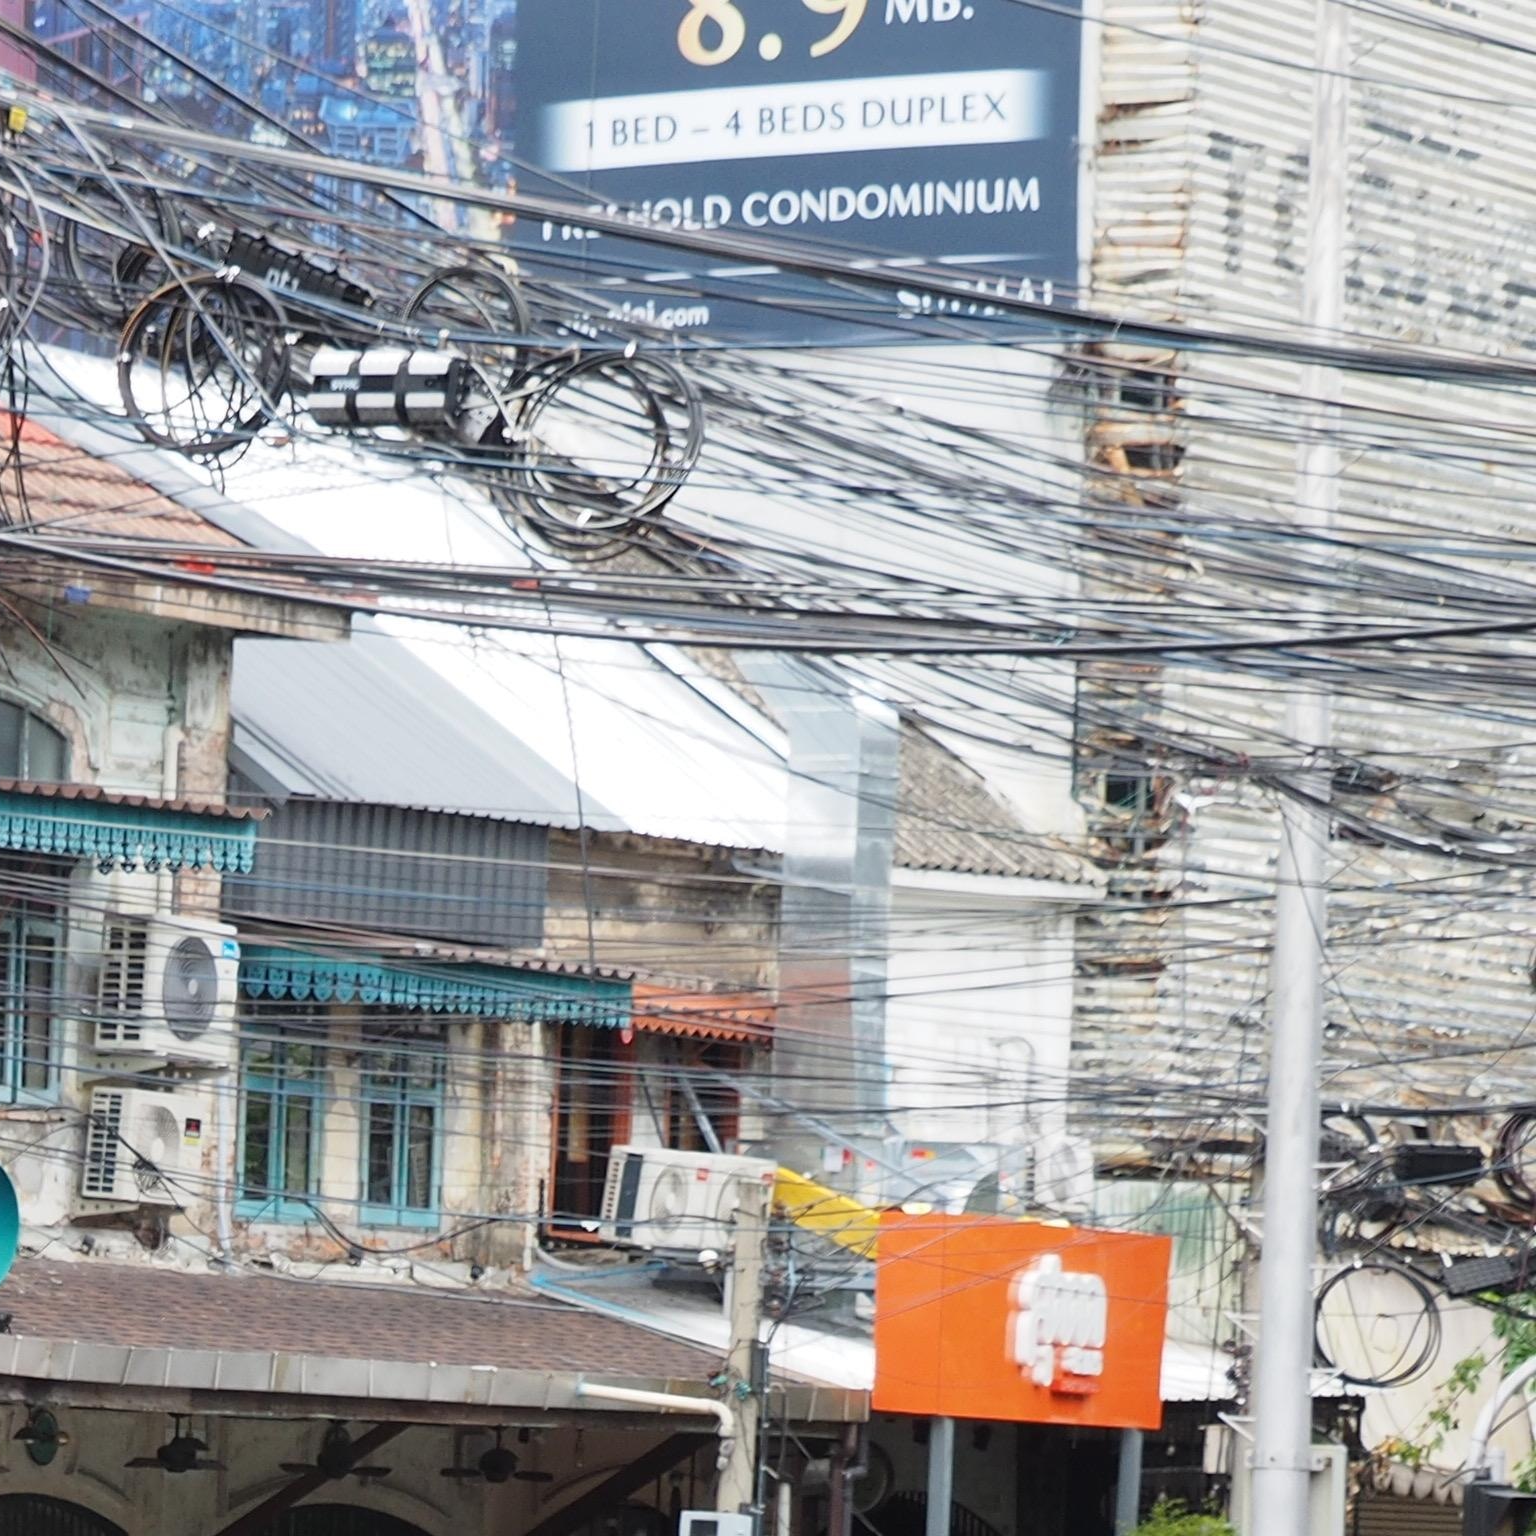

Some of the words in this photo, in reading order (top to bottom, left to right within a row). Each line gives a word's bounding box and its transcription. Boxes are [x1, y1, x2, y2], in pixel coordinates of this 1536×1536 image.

[584, 120, 595, 149] 1
[611, 114, 678, 147] BED
[725, 110, 742, 139] 4
[758, 101, 847, 136] BEDS
[862, 91, 1008, 130] DUPLEX
[742, 177, 1041, 227] CONDOMINIUM
